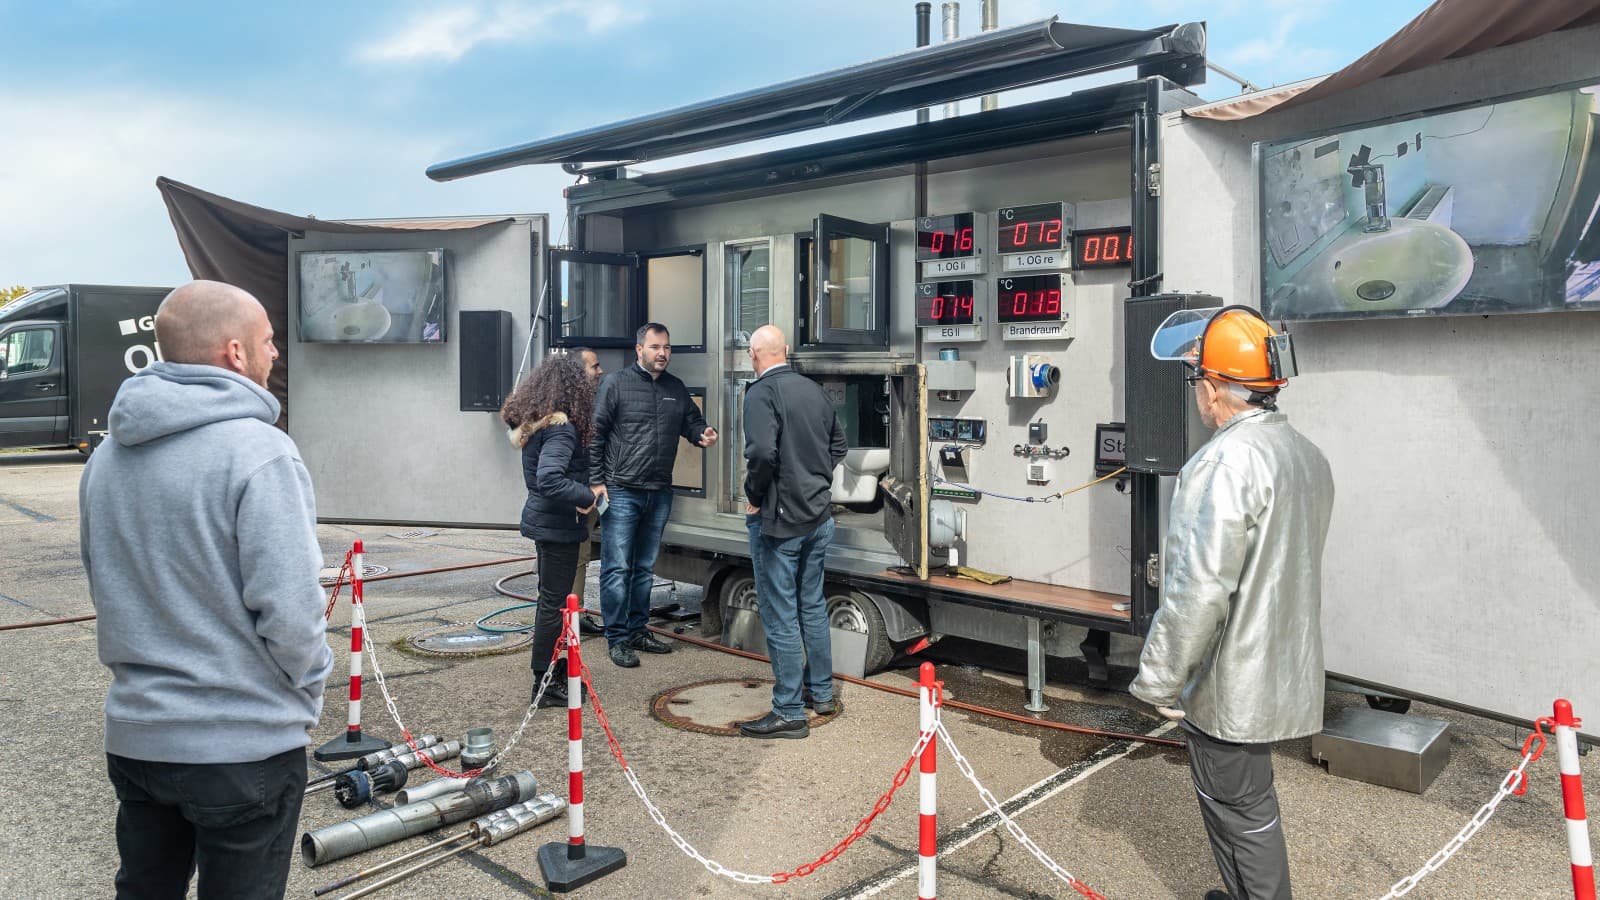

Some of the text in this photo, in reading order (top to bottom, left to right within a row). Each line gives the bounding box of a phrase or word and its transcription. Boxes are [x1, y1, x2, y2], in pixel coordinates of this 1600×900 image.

[931, 227, 973, 253] 016
[1014, 219, 1062, 246] 012
[938, 263, 944, 272] 1.
[945, 261, 959, 272] OG
[1017, 257, 1025, 266] 1.
[1027, 256, 1042, 265] OG
[931, 297, 973, 319] 014
[1013, 291, 1060, 315] 013
[138, 314, 158, 331] G
[1010, 325, 1060, 335] Brandraum
[942, 329, 954, 337] EG
[1103, 438, 1126, 453] St
